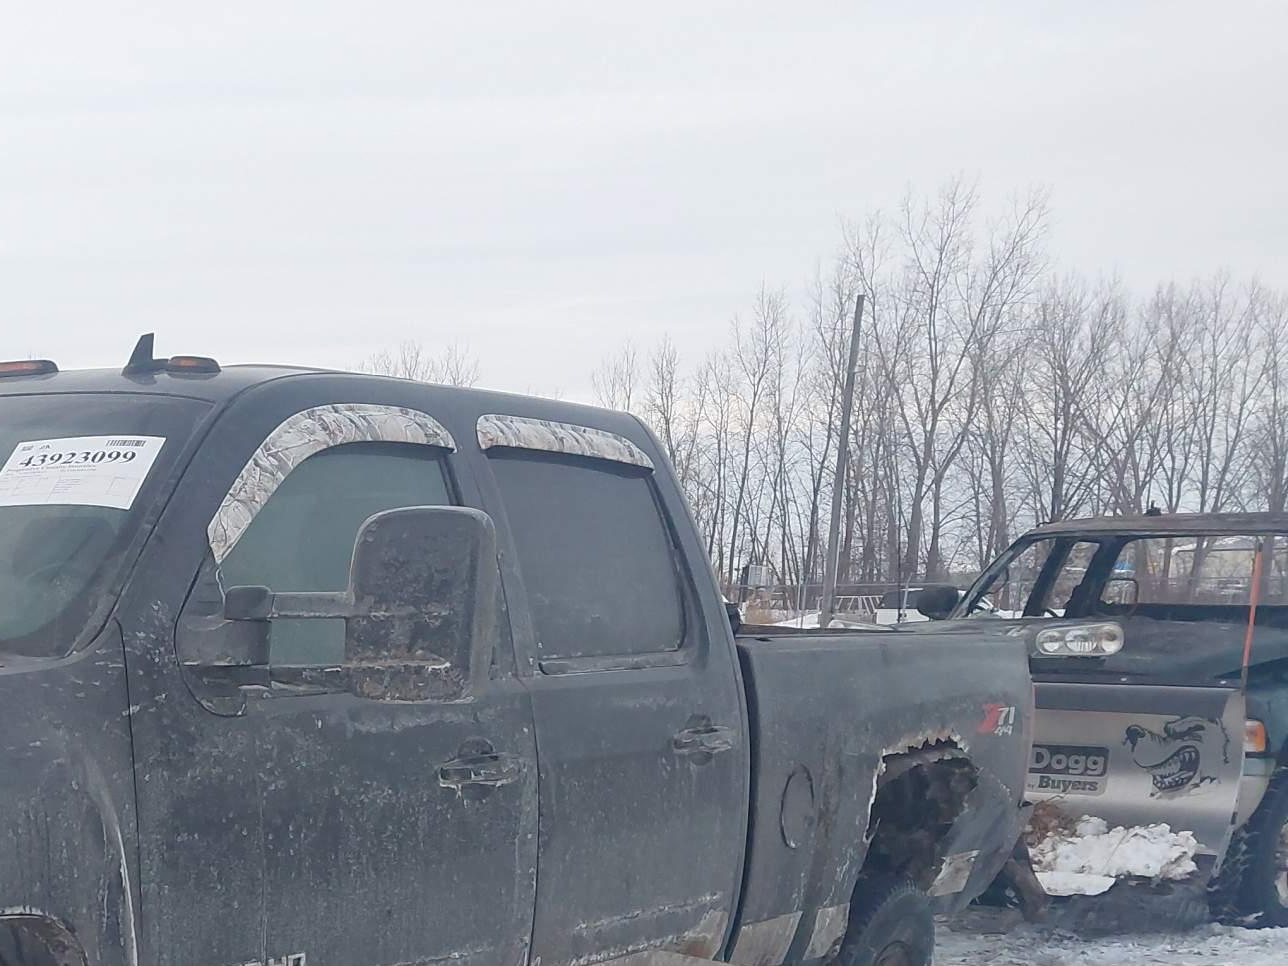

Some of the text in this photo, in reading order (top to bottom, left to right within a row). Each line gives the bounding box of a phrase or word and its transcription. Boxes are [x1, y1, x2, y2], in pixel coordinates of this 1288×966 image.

[20, 451, 136, 466] 43923099
[1031, 747, 1105, 775] Dogg
[1038, 775, 1098, 793] Buyers
